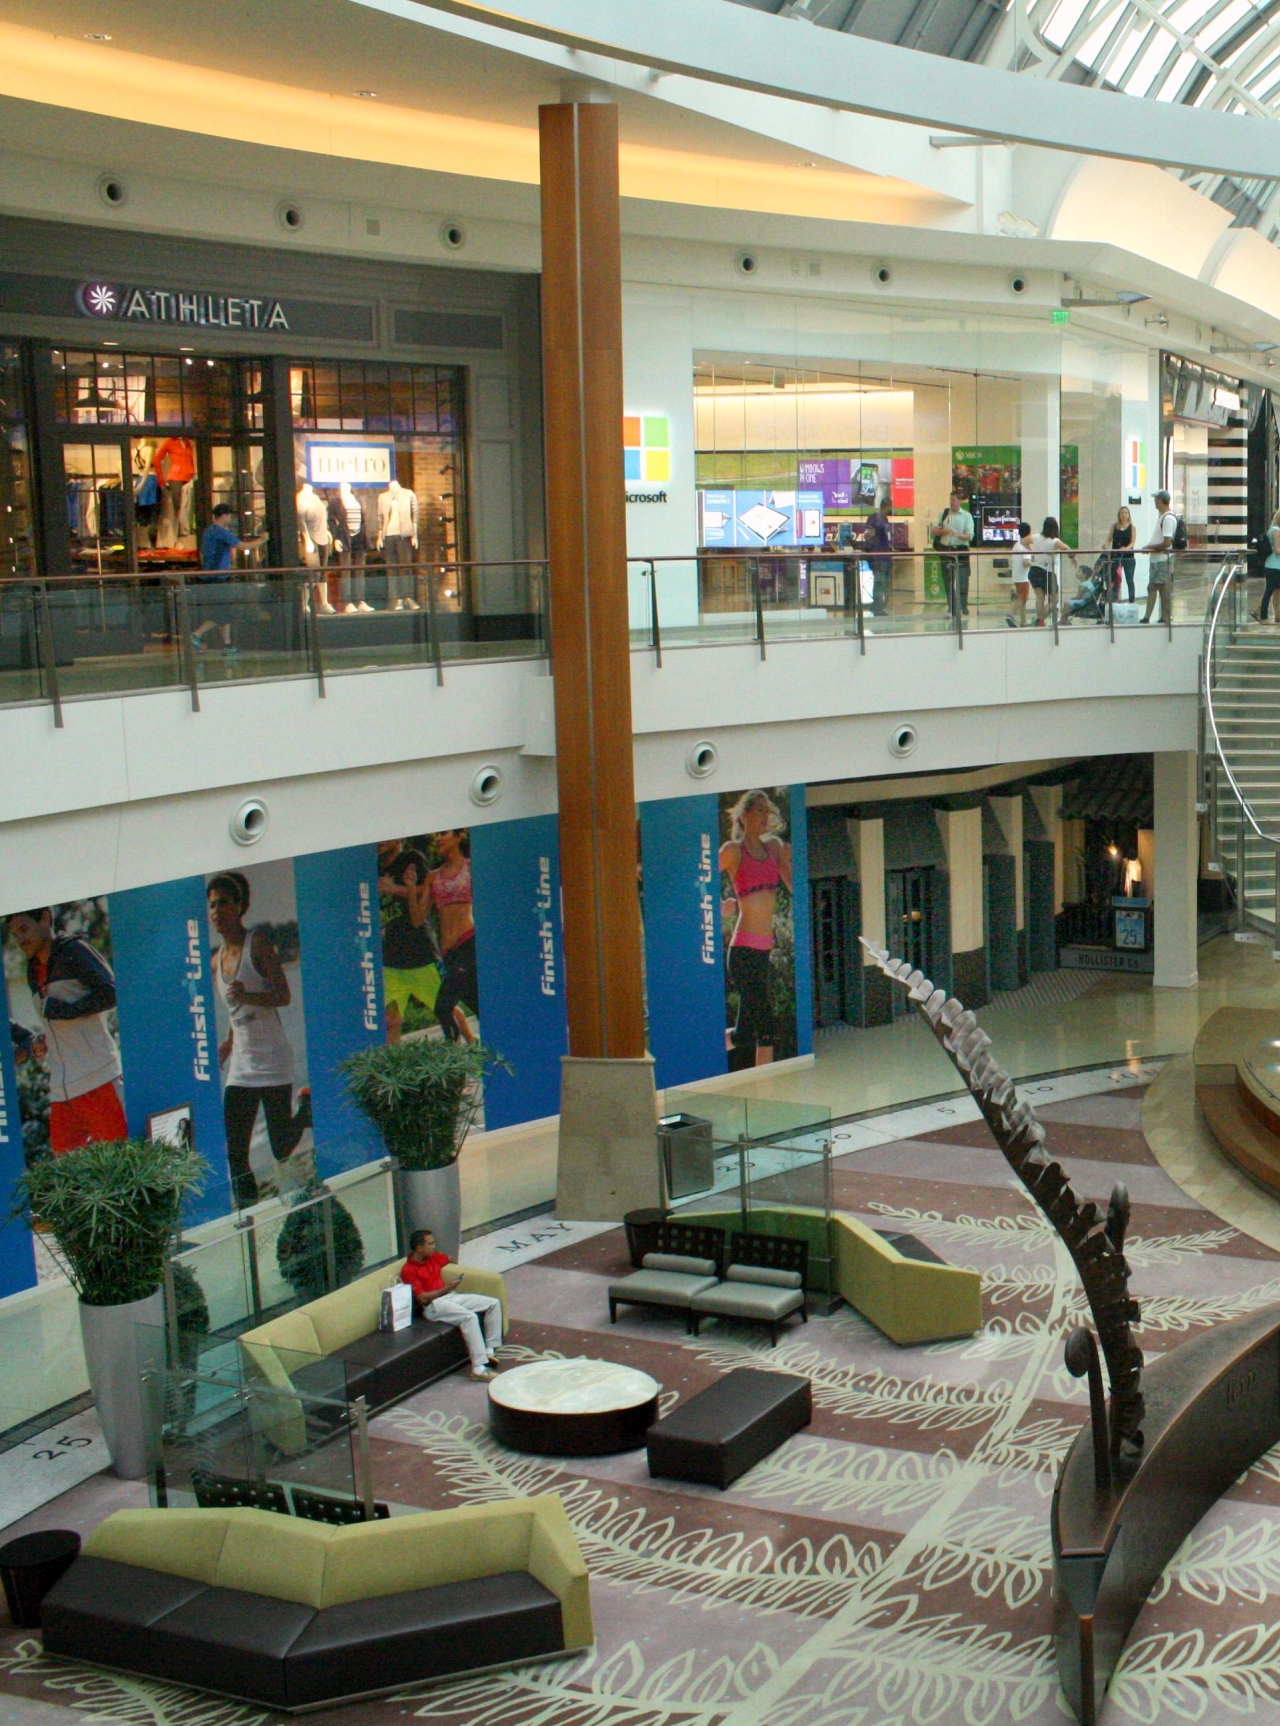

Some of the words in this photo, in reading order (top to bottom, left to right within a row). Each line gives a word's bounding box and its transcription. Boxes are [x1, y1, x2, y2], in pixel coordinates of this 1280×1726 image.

[127, 290, 289, 329] ATHLETA
[319, 456, 386, 474] metro
[625, 490, 668, 503] icrosoft
[698, 834, 712, 883] Line
[538, 856, 551, 911] Line
[356, 882, 371, 941] Line
[699, 895, 715, 964] Finish
[184, 918, 202, 981] Line
[538, 922, 556, 996] Finish
[1079, 953, 1125, 967] HOLLISTER
[360, 951, 378, 1030] Finish
[189, 994, 211, 1081] Finish
[937, 1105, 956, 1116] 5
[495, 1222, 575, 1253] MAY
[32, 1435, 93, 1461] 25
